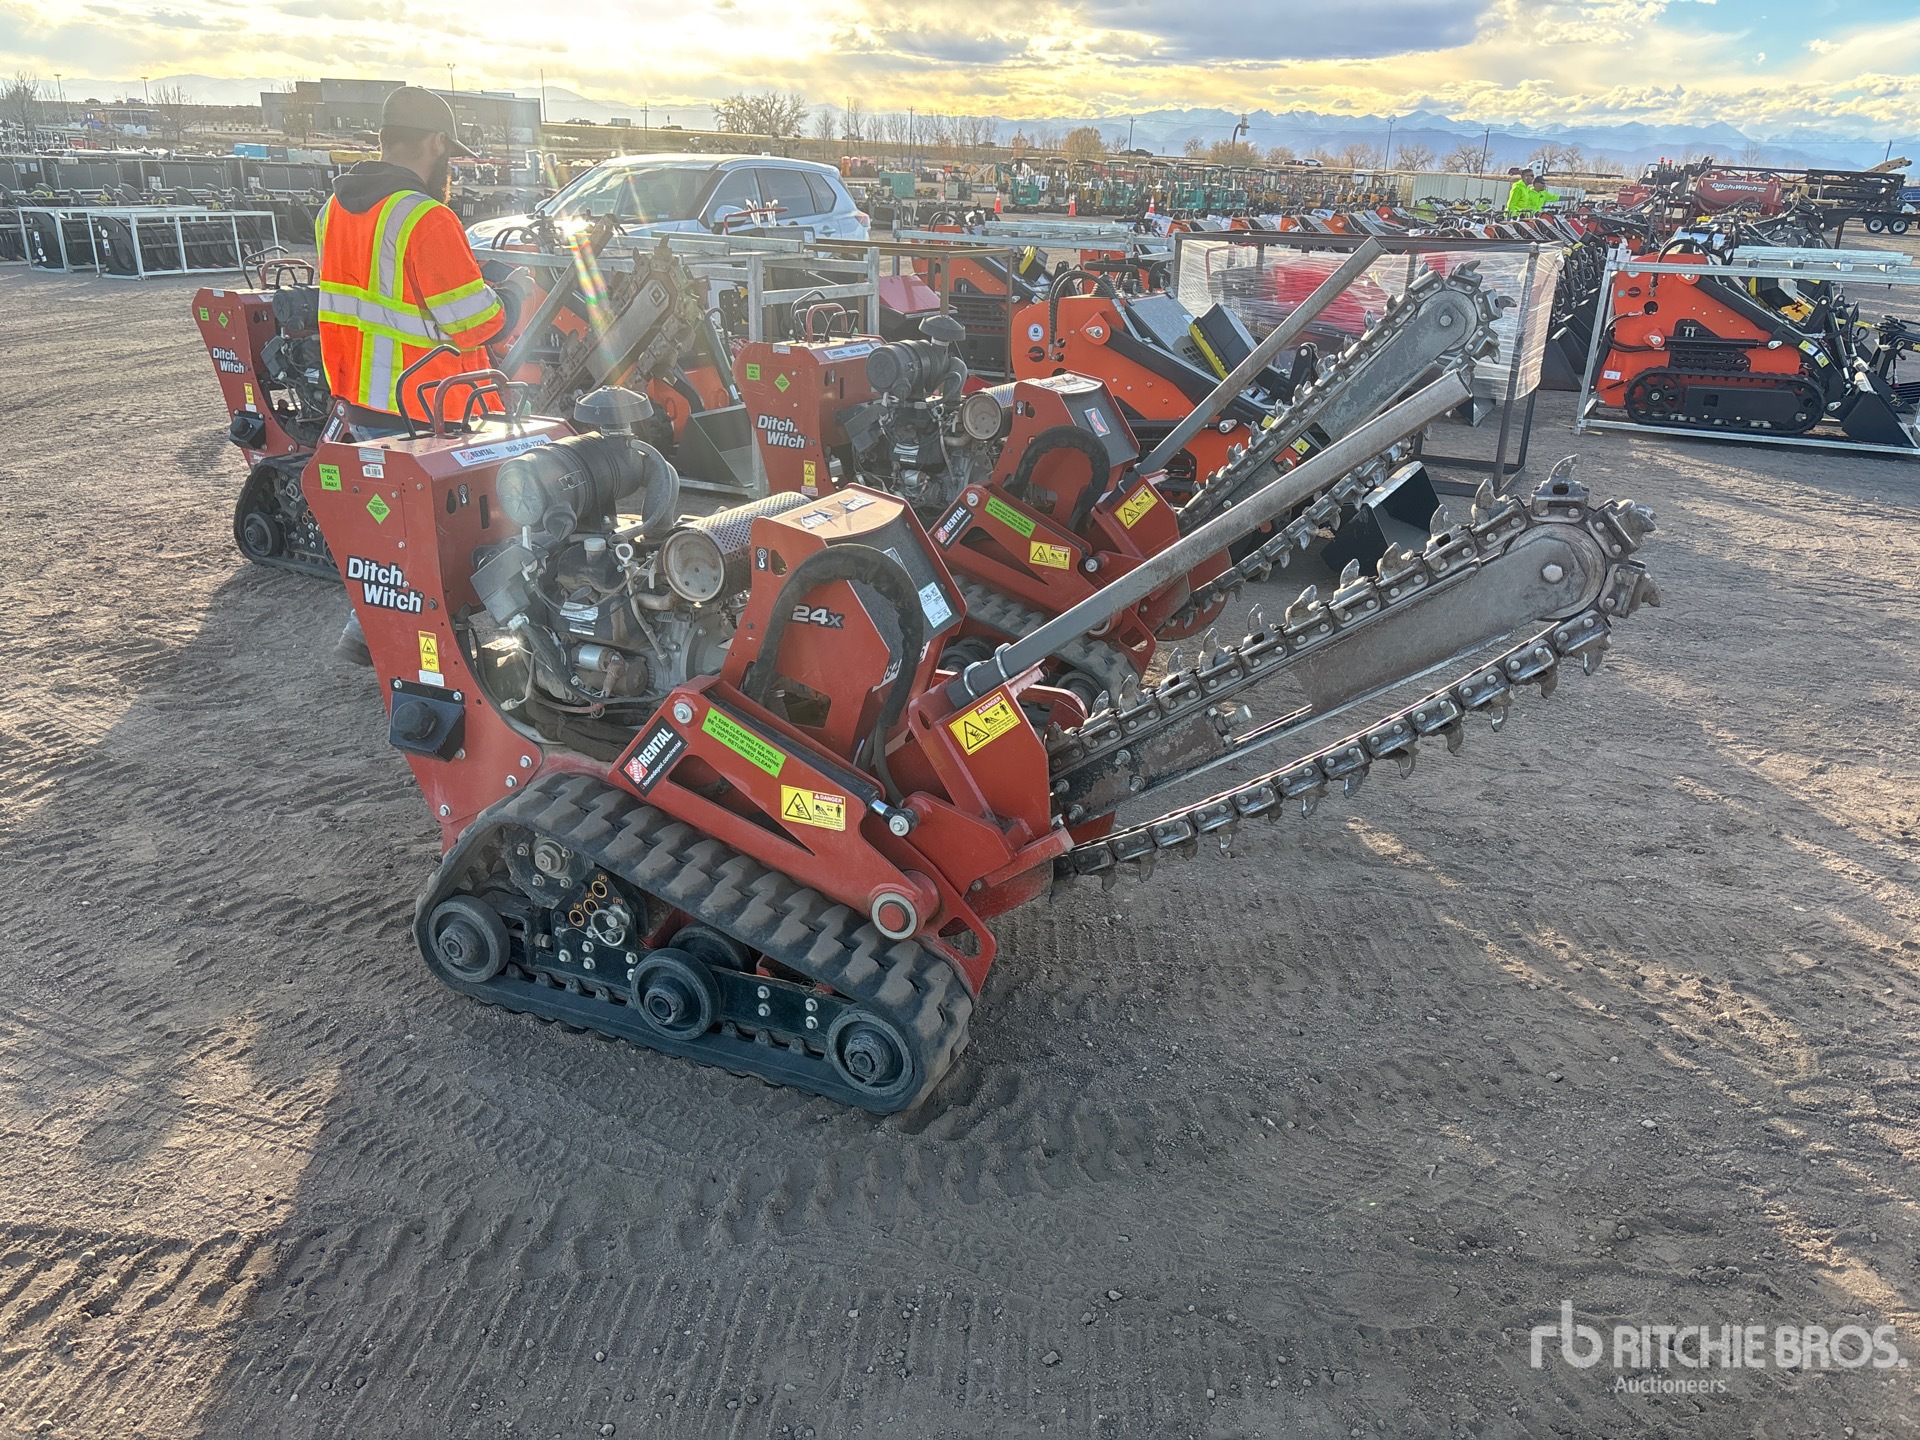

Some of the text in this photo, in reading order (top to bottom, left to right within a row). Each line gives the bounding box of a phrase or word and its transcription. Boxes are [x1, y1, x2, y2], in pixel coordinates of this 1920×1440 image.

[212, 347, 236, 360] Ditch
[220, 361, 244, 374] Witch
[758, 415, 794, 432] Ditch
[767, 431, 805, 448] Witch
[470, 448, 496, 458] RENTAL
[943, 506, 967, 533] RENTAL
[348, 557, 403, 586] Ditch
[364, 583, 422, 612] Witch
[981, 696, 1001, 712] DANGER
[637, 728, 674, 768] RENTAL
[715, 723, 739, 741] CHARGED
[746, 743, 756, 752] THIS
[757, 750, 780, 768] MACHINE
[716, 730, 727, 740] NOT
[728, 738, 754, 758] RETURNED
[755, 754, 772, 769] CLEAN
[730, 726, 754, 744] CLEANING
[755, 742, 765, 752] FEE
[820, 794, 842, 803] DANGER
